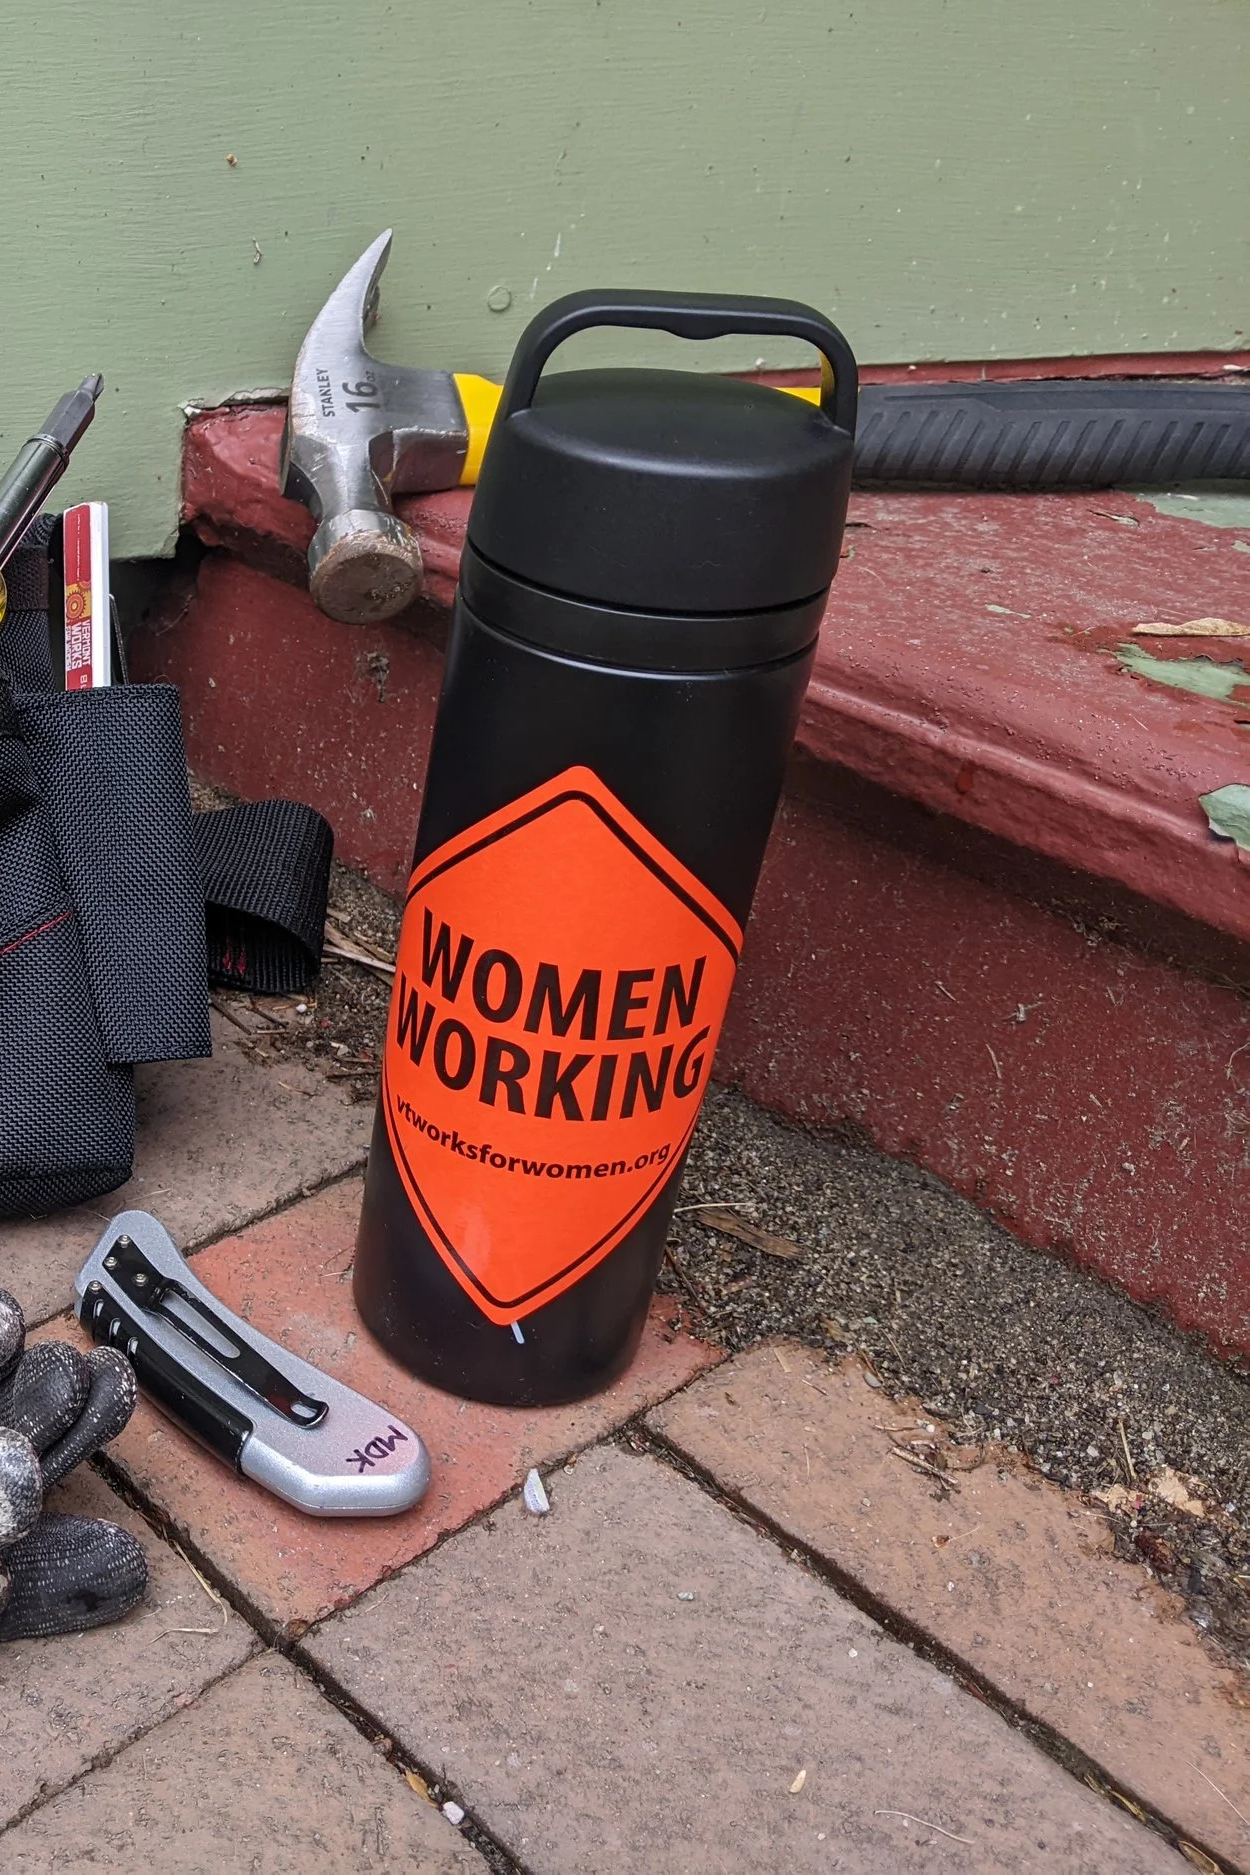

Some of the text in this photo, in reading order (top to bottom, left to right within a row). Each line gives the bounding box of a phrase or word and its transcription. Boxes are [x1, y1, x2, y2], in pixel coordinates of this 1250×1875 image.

[316, 368, 336, 418] STANLEY
[71, 621, 83, 670] WORKS
[81, 619, 91, 666] VERMONT
[421, 905, 707, 1042] WOMEN
[396, 971, 711, 1122] WORKING
[396, 1093, 671, 1180] vtworksforwomen.org
[345, 1424, 408, 1474] MDK
